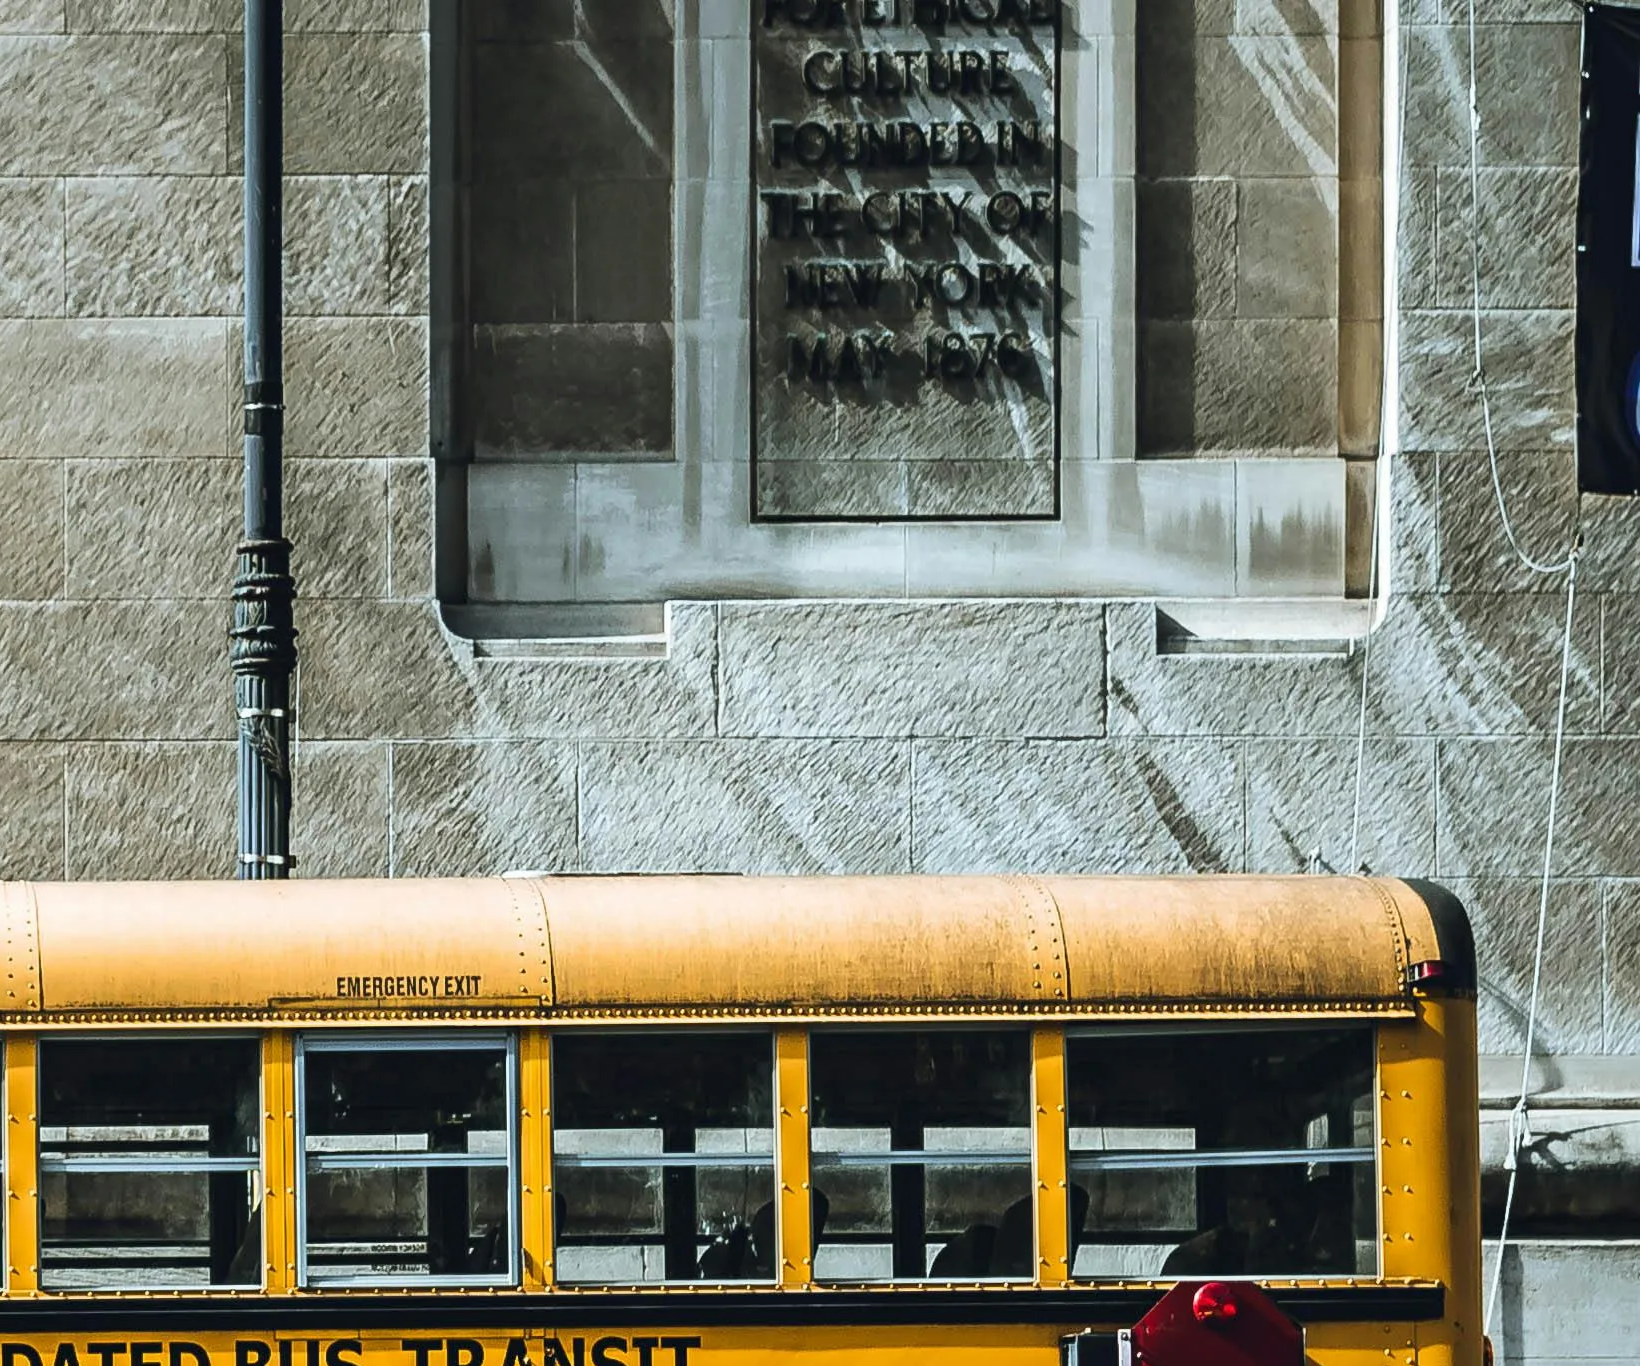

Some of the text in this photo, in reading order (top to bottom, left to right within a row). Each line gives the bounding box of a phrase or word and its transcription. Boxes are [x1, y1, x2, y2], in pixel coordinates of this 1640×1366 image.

[803, 50, 1013, 94] CULTURE
[770, 120, 1043, 168] FOUNDED IN
[760, 190, 1053, 239] THE CITY OF
[785, 262, 1041, 309] NEW YORK
[785, 333, 894, 382] MAY
[336, 975, 482, 998] EMERGENCY EXIT
